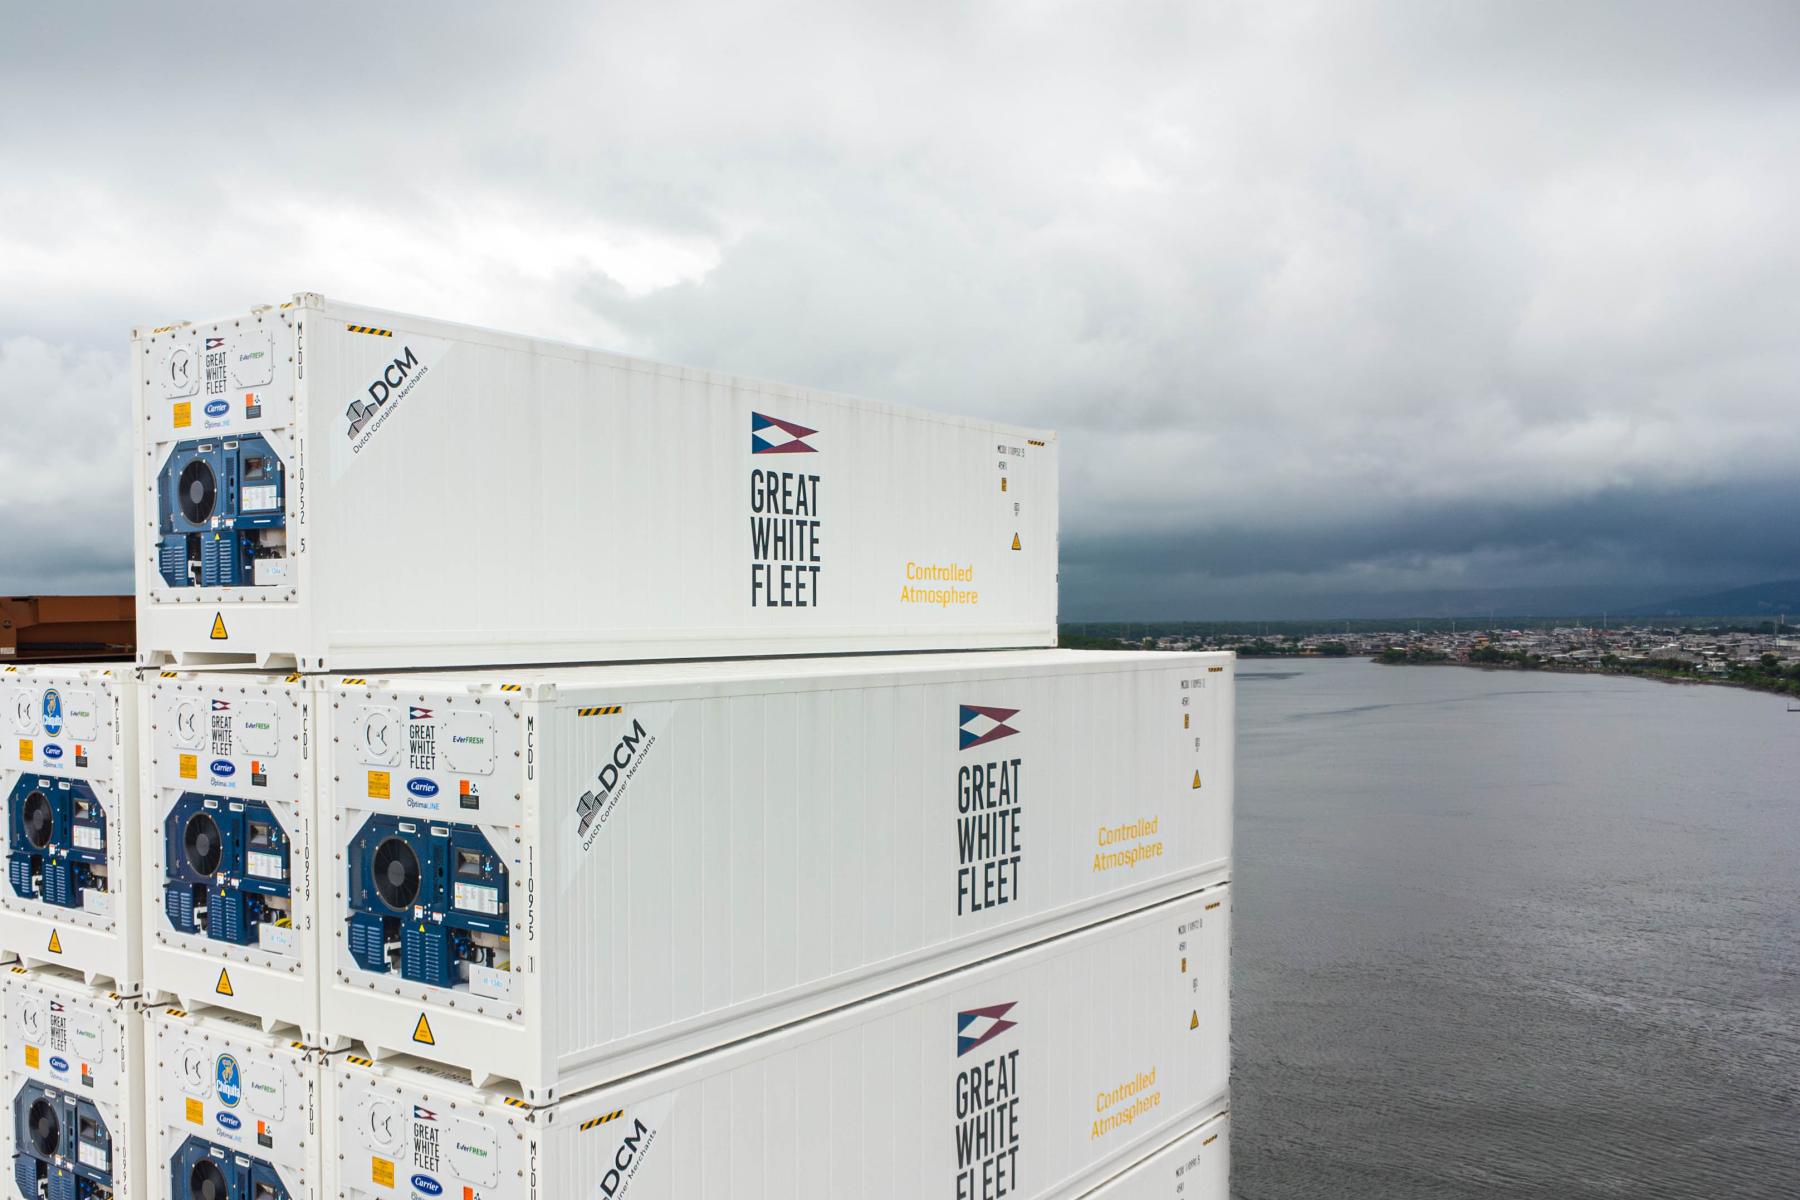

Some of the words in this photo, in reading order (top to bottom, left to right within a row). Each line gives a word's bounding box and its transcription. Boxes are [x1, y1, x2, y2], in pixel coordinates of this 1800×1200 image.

[206, 352, 226, 368] GREAT
[206, 366, 227, 381] WHITE
[368, 345, 419, 407] DCM
[206, 379, 227, 395] FLEET
[207, 402, 229, 414] Carrier
[352, 430, 373, 454] Dutch
[371, 399, 399, 433] Container
[397, 365, 429, 401] Merchants
[751, 469, 820, 516] GREAT
[750, 516, 820, 562] WHITE
[906, 562, 973, 582] Controlled
[751, 564, 820, 607] FLEET
[900, 586, 978, 607] Atmosphere
[211, 715, 232, 729] GREAT
[211, 729, 232, 743] WHITE
[409, 724, 435, 741] GREAT
[212, 742, 232, 757] FLEET
[409, 740, 436, 755] WHITE
[598, 718, 646, 793] DCM
[213, 763, 233, 773] Carrier
[410, 755, 436, 771] FLEET
[410, 780, 436, 793] Carrier
[582, 823, 602, 852] Dutch
[600, 780, 628, 823] Container
[626, 735, 656, 780] Merchants
[957, 758, 1021, 814] GREAT
[957, 807, 1021, 864] WHITE
[1098, 815, 1159, 846] Controlled
[1093, 841, 1163, 873] Atmosphere
[957, 856, 1021, 916] FLEET
[51, 1014, 66, 1029] GREAT
[50, 1026, 67, 1041] WHITE
[51, 1038, 67, 1053] FLEET
[956, 1049, 1019, 1120] GREAT
[1095, 1064, 1156, 1113] Controlled
[218, 1114, 239, 1127] Carrier
[1090, 1091, 1161, 1140] Atmosphere
[413, 1122, 439, 1142] GREAT
[955, 1097, 1019, 1170] WHITE
[414, 1138, 440, 1159] WHITE
[600, 1118, 648, 1198] DCM
[627, 1130, 657, 1180] Merchants
[414, 1153, 440, 1173] FLEET
[414, 1176, 439, 1191] Carrier
